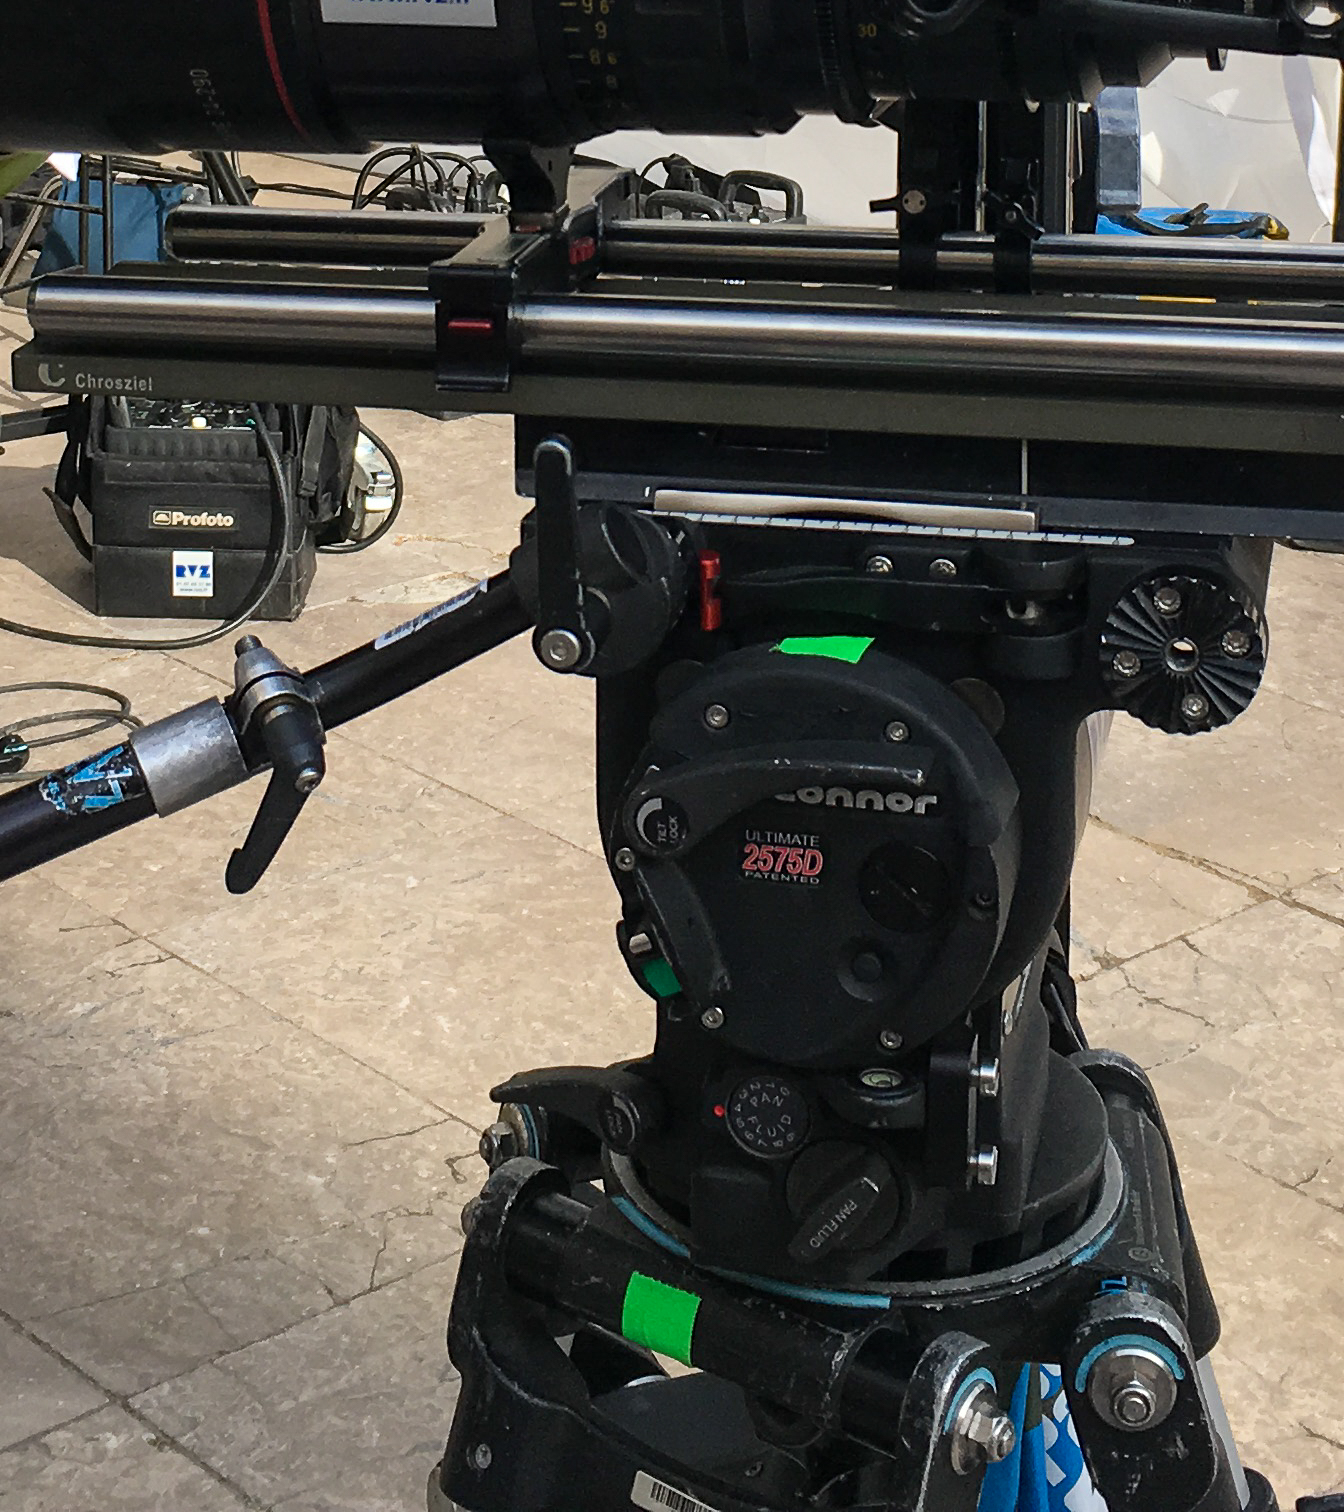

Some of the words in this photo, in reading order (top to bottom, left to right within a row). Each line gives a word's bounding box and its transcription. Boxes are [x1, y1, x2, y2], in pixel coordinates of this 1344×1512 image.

[594, 20, 607, 39] 9
[75, 373, 153, 392] Chrosziel
[171, 511, 234, 527] Profoto
[176, 564, 211, 578] RVZ
[745, 829, 820, 847] ULTIMATE
[742, 842, 824, 876] 2575D
[745, 870, 820, 885] PATENTED
[749, 1092, 784, 1107] PAN
[747, 1114, 792, 1137] FLUID
[835, 1198, 858, 1223] PAN
